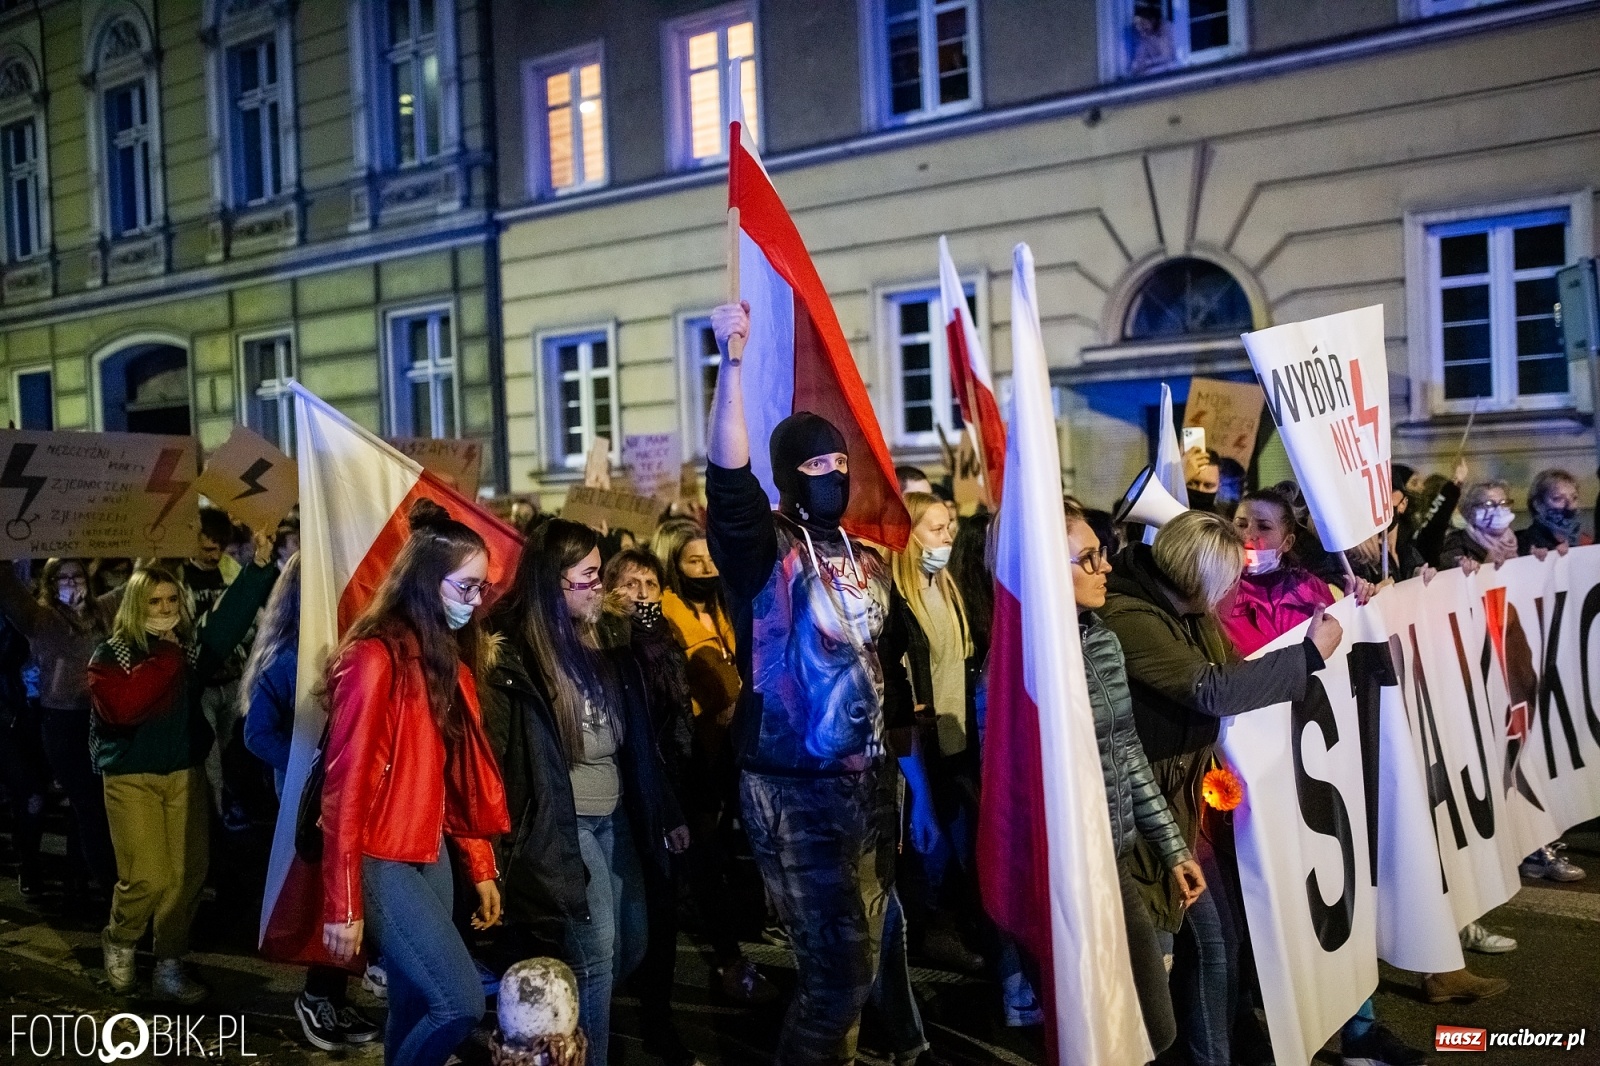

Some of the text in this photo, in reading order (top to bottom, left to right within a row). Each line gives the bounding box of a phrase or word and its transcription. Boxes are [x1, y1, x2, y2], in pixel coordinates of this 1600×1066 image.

[1257, 345, 1350, 427] WYBÓR
[1330, 415, 1368, 475] NIE
[1291, 597, 1497, 952] STAJ
